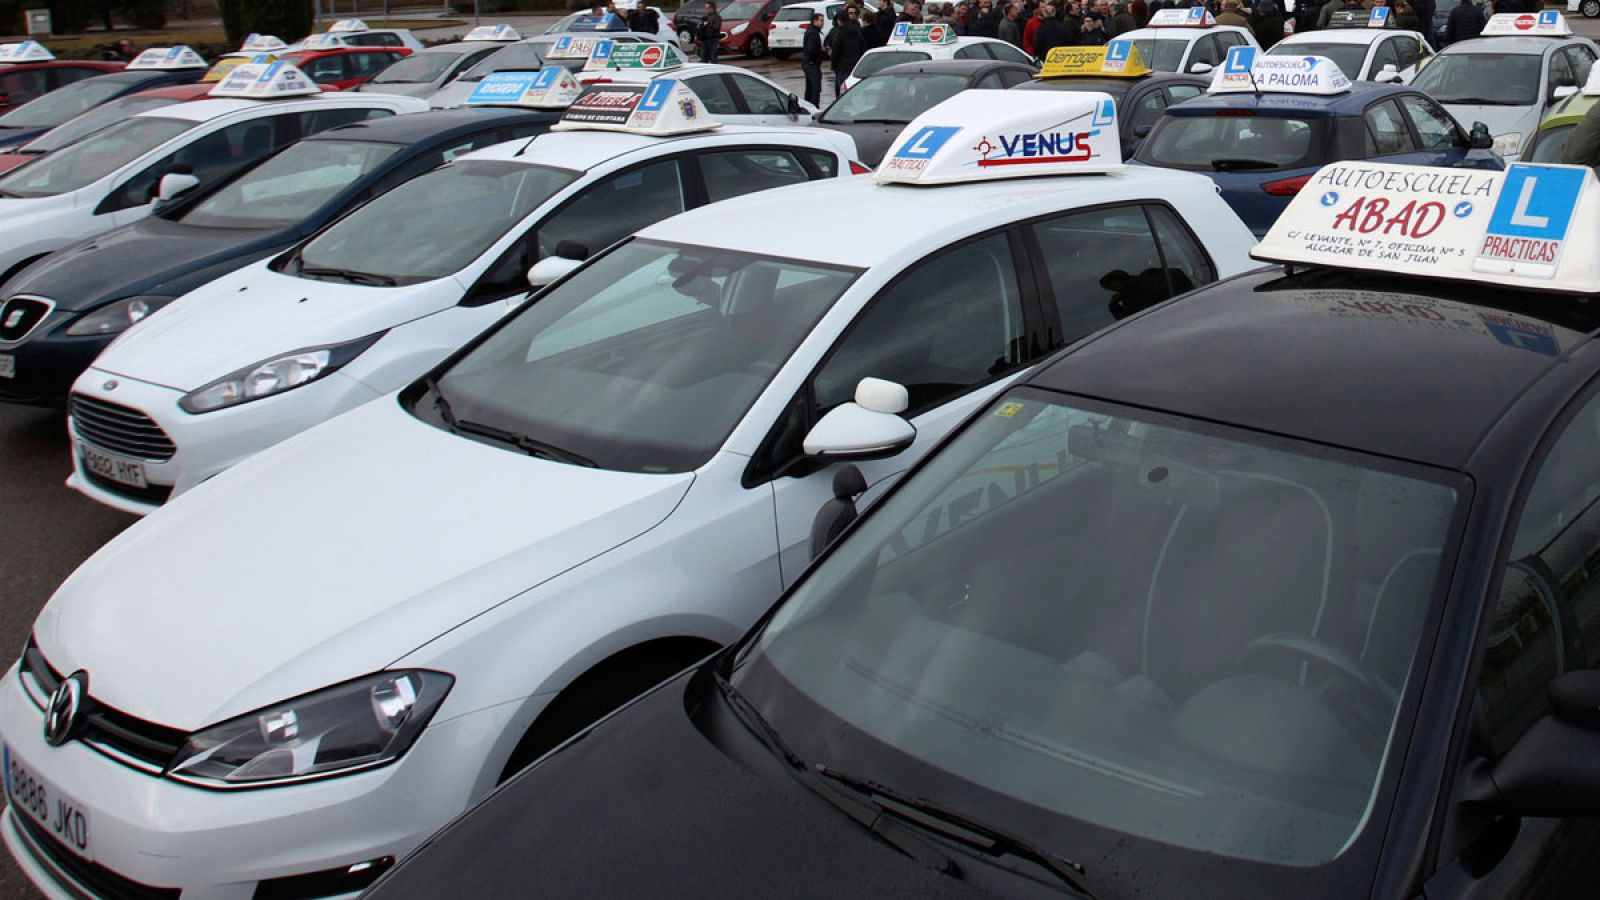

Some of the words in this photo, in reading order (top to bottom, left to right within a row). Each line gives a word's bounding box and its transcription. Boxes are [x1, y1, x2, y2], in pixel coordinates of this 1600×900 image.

[1112, 44, 1122, 58] L
[1232, 52, 1244, 69] L
[1255, 60, 1306, 69] AUTOESCUELA
[535, 70, 549, 86] L
[1252, 73, 1265, 85] LA
[1268, 73, 1319, 86] PALOMA
[645, 83, 660, 107] L
[908, 130, 935, 153] L
[999, 132, 1092, 160] VENUS
[886, 158, 928, 169] PRACTICAS
[1318, 167, 1494, 197] AUTOESCUELA
[1510, 175, 1549, 229] L
[1331, 196, 1446, 240] ABAD
[1305, 243, 1353, 255] ALCAZAR
[1357, 248, 1373, 258] DE
[1377, 250, 1401, 260] SAN
[1403, 253, 1440, 265] JUAN
[1388, 242, 1436, 255] OFICINA
[1482, 235, 1559, 263] PRACTICAS
[54, 799, 88, 850] JKD
